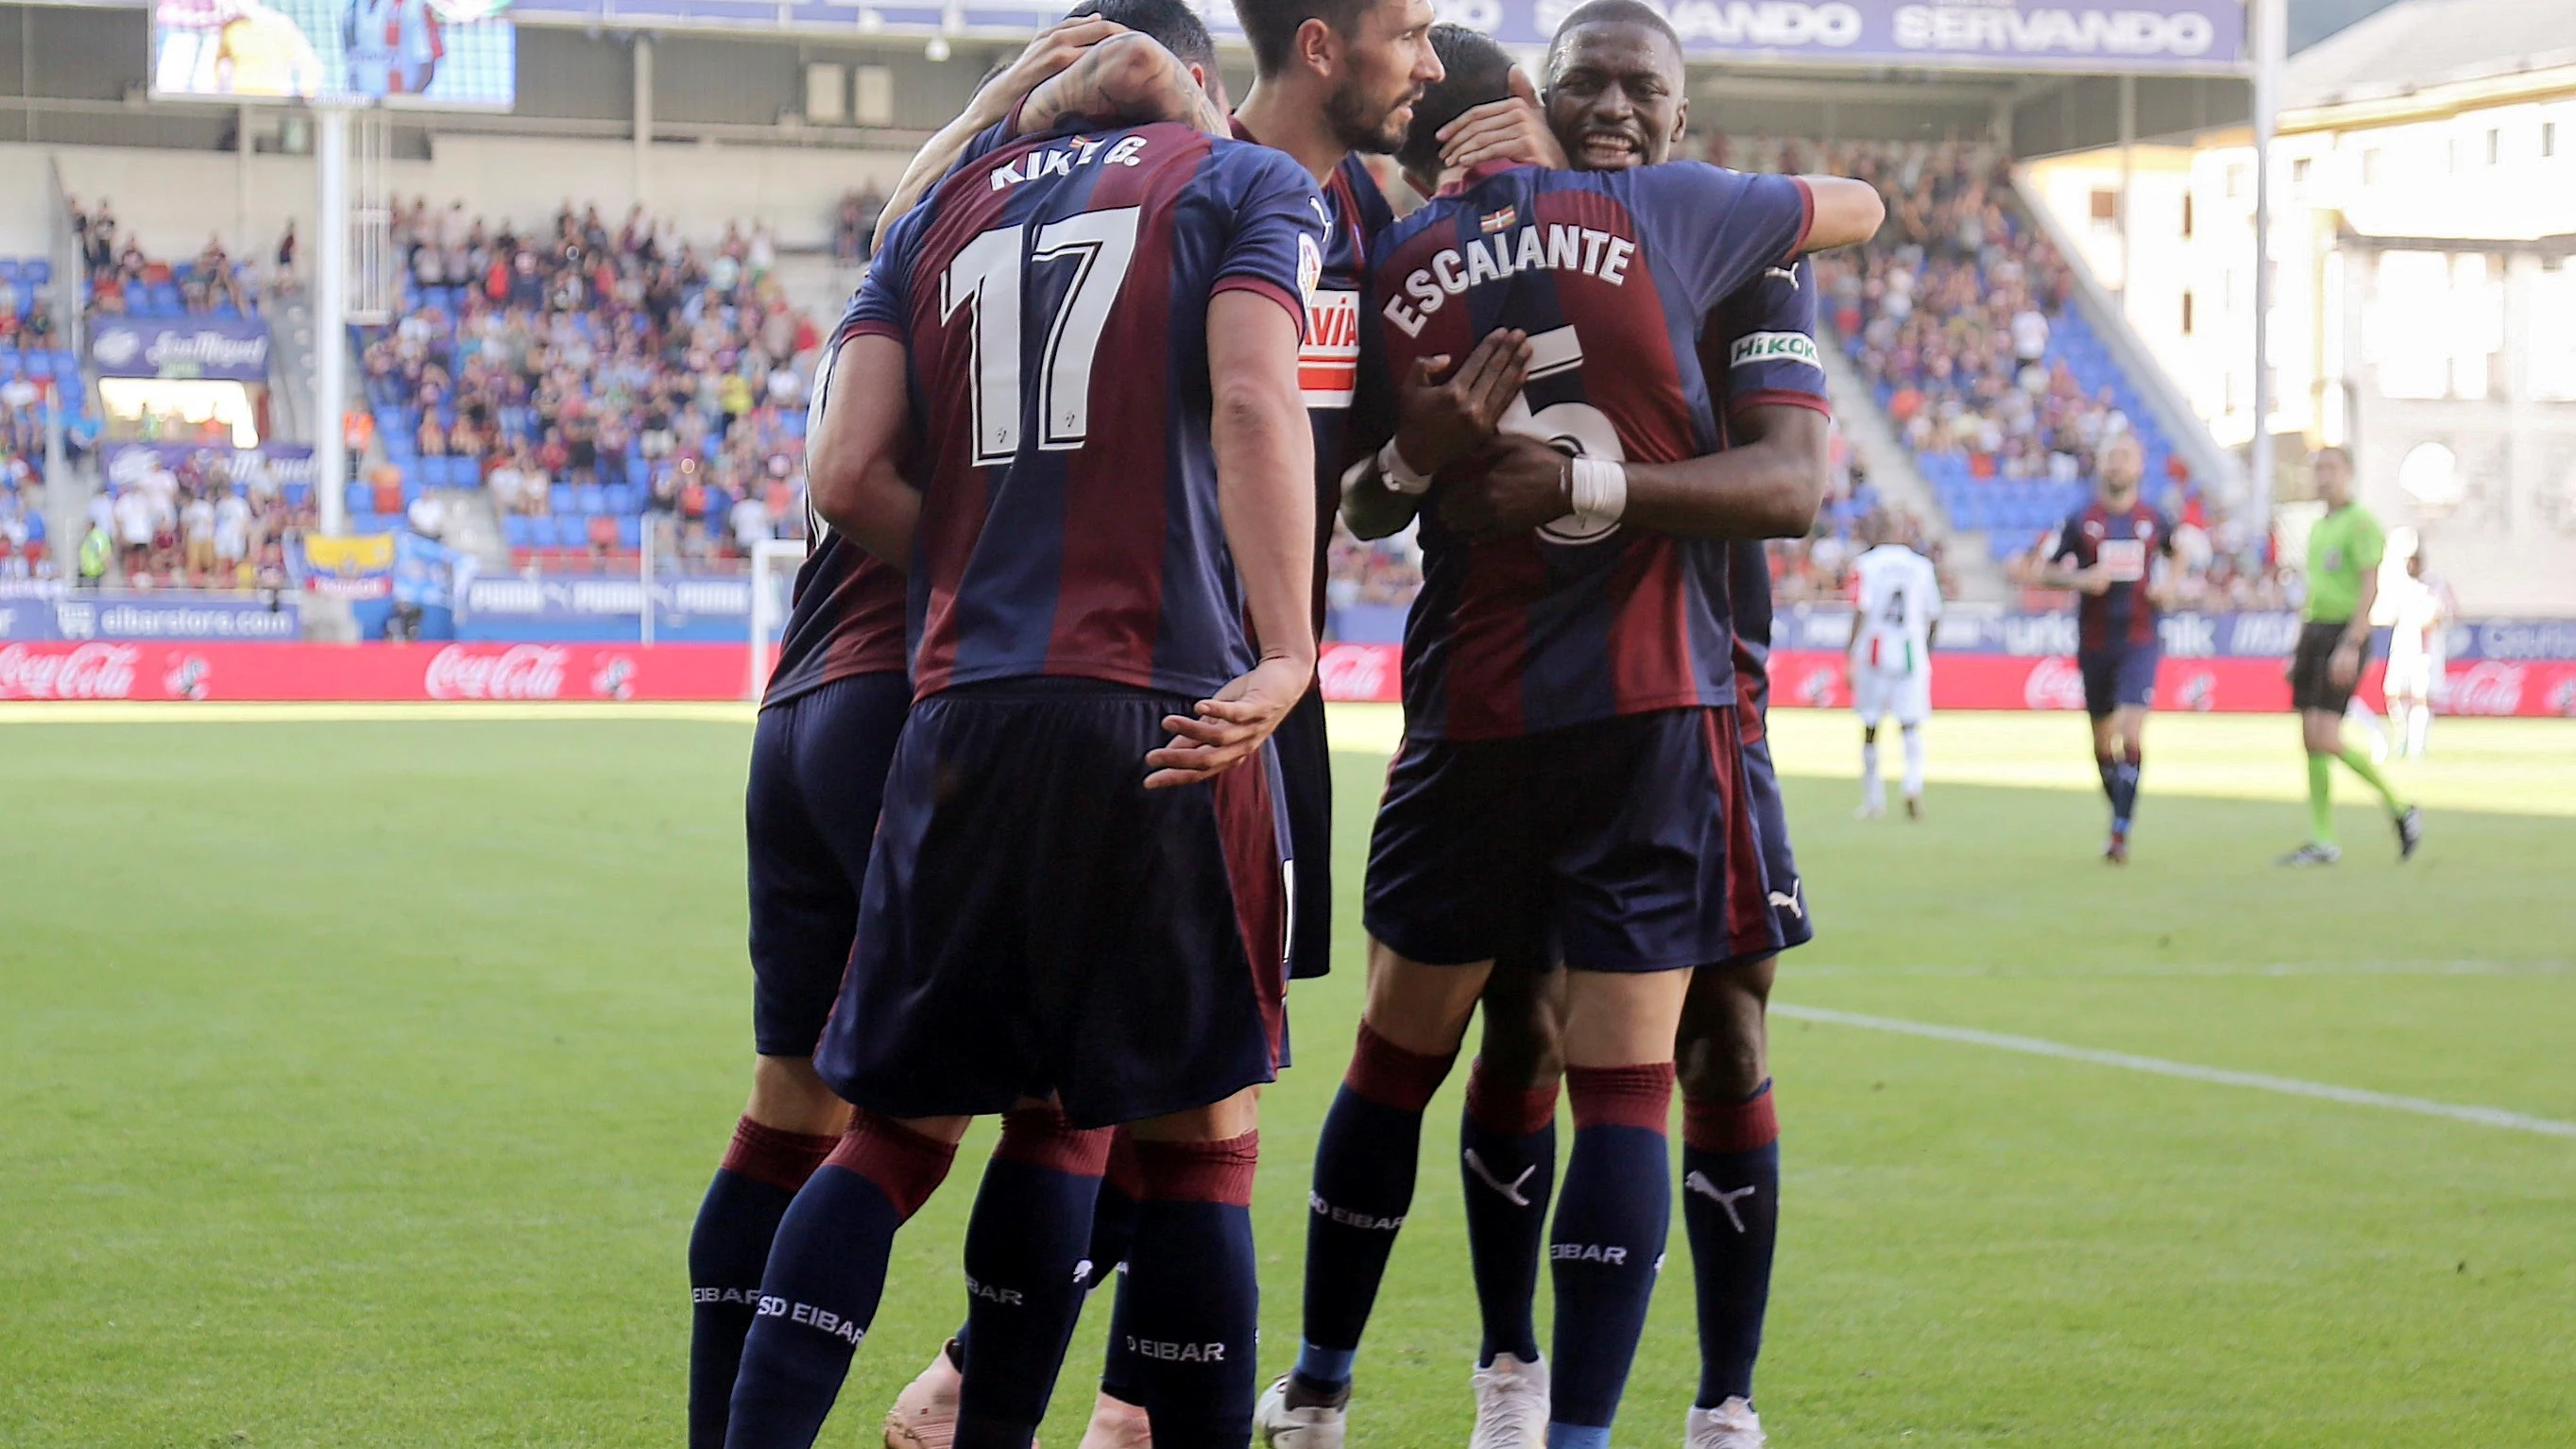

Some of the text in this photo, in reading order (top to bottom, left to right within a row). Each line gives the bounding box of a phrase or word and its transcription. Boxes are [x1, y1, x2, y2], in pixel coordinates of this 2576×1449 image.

[1892, 4, 2213, 57] SERVANDO
[1382, 223, 1635, 339] ESCALANTE
[939, 205, 1141, 467] 17
[425, 642, 570, 700] Coca-Cola
[757, 1295, 788, 1317] SD
[1140, 1338, 1225, 1361] EIBAR
